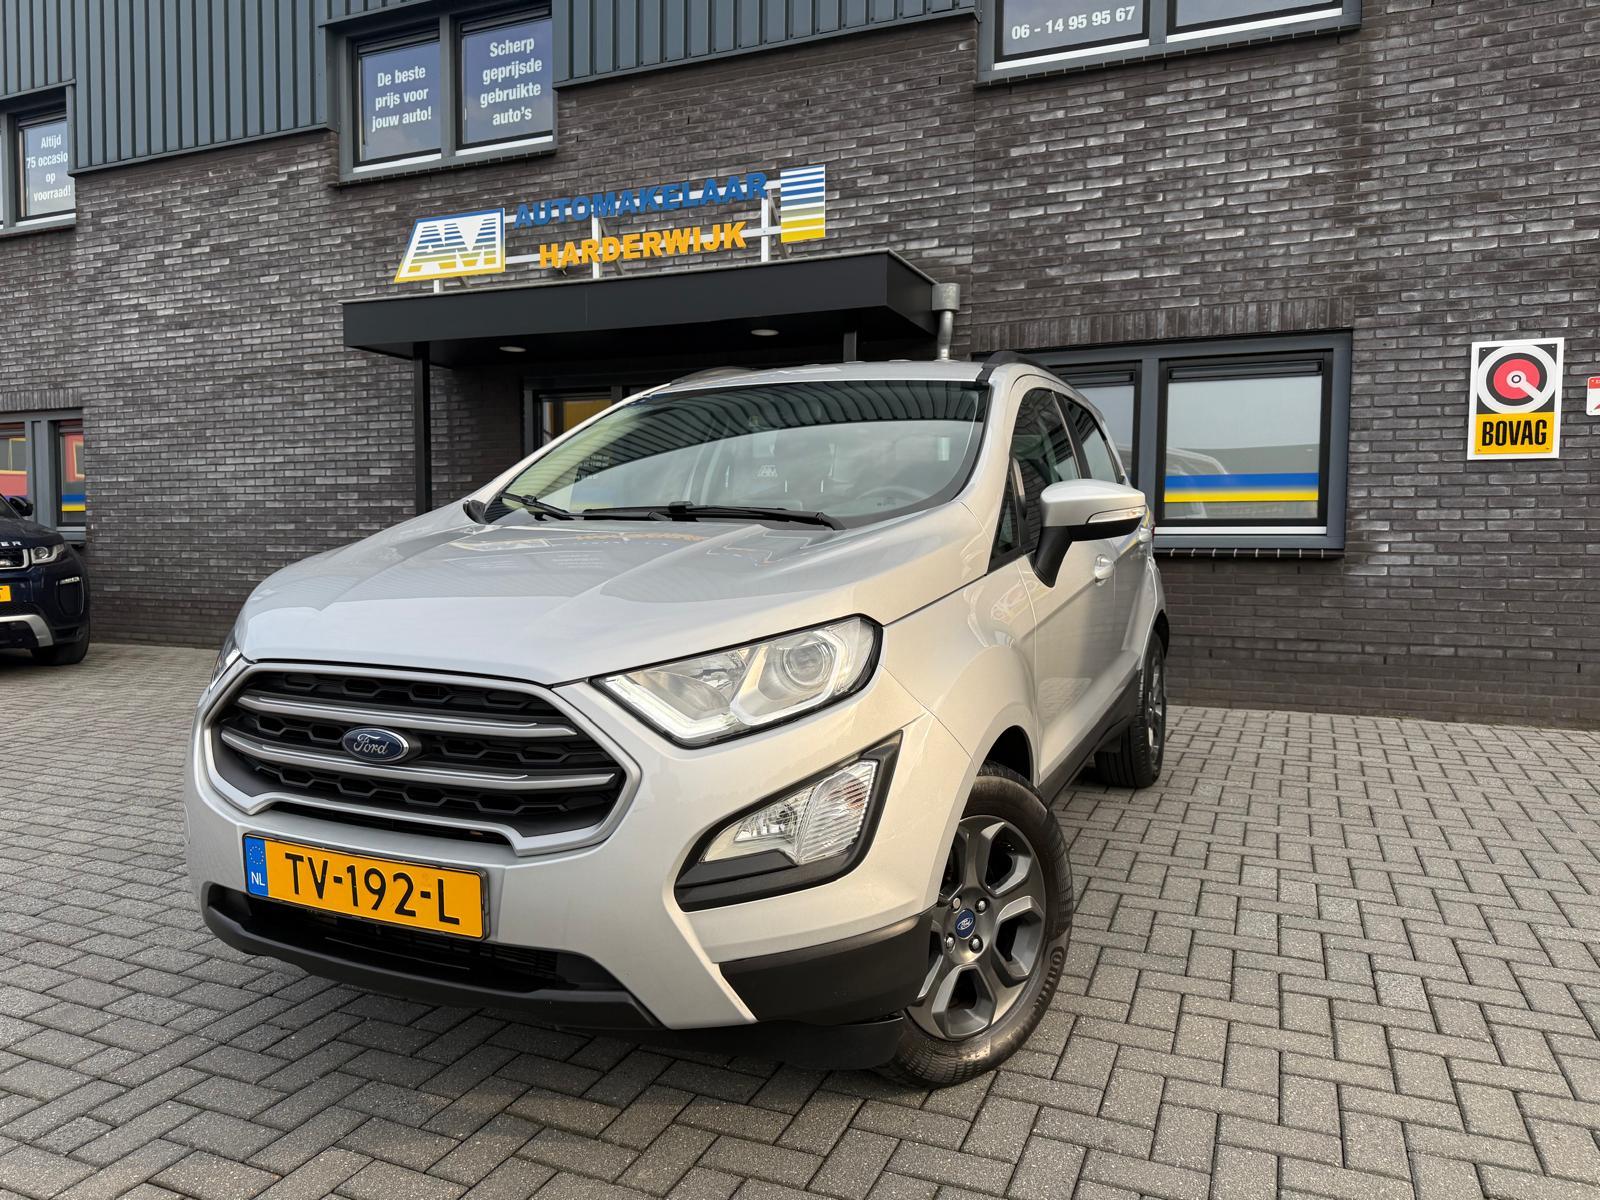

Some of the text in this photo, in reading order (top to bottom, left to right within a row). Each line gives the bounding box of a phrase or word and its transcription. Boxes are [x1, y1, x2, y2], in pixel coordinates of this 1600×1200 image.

[1011, 24, 1030, 40] 06
[1045, 18, 1064, 34] 14
[1068, 14, 1087, 30] 95
[1091, 10, 1111, 26] 95
[1115, 5, 1136, 22] 67
[489, 37, 535, 58] Scherp
[377, 65, 426, 88] De beste
[482, 57, 543, 85] geprijsde
[375, 87, 430, 111] prijs voor
[480, 82, 542, 108] gebruikte
[371, 106, 432, 133] jouw auto!
[492, 106, 533, 126] auto's
[40, 134, 62, 149] Altijd
[26, 155, 36, 169] 75
[45, 172, 56, 184] op
[33, 184, 71, 202] voorraad!
[513, 171, 769, 229] AUTOMAKELAAR
[538, 220, 747, 269] HARDERWIJK
[1481, 419, 1548, 446] BOVAG
[353, 733, 390, 755] Ford
[251, 871, 266, 887] NL
[284, 852, 461, 926] TV-192-L
